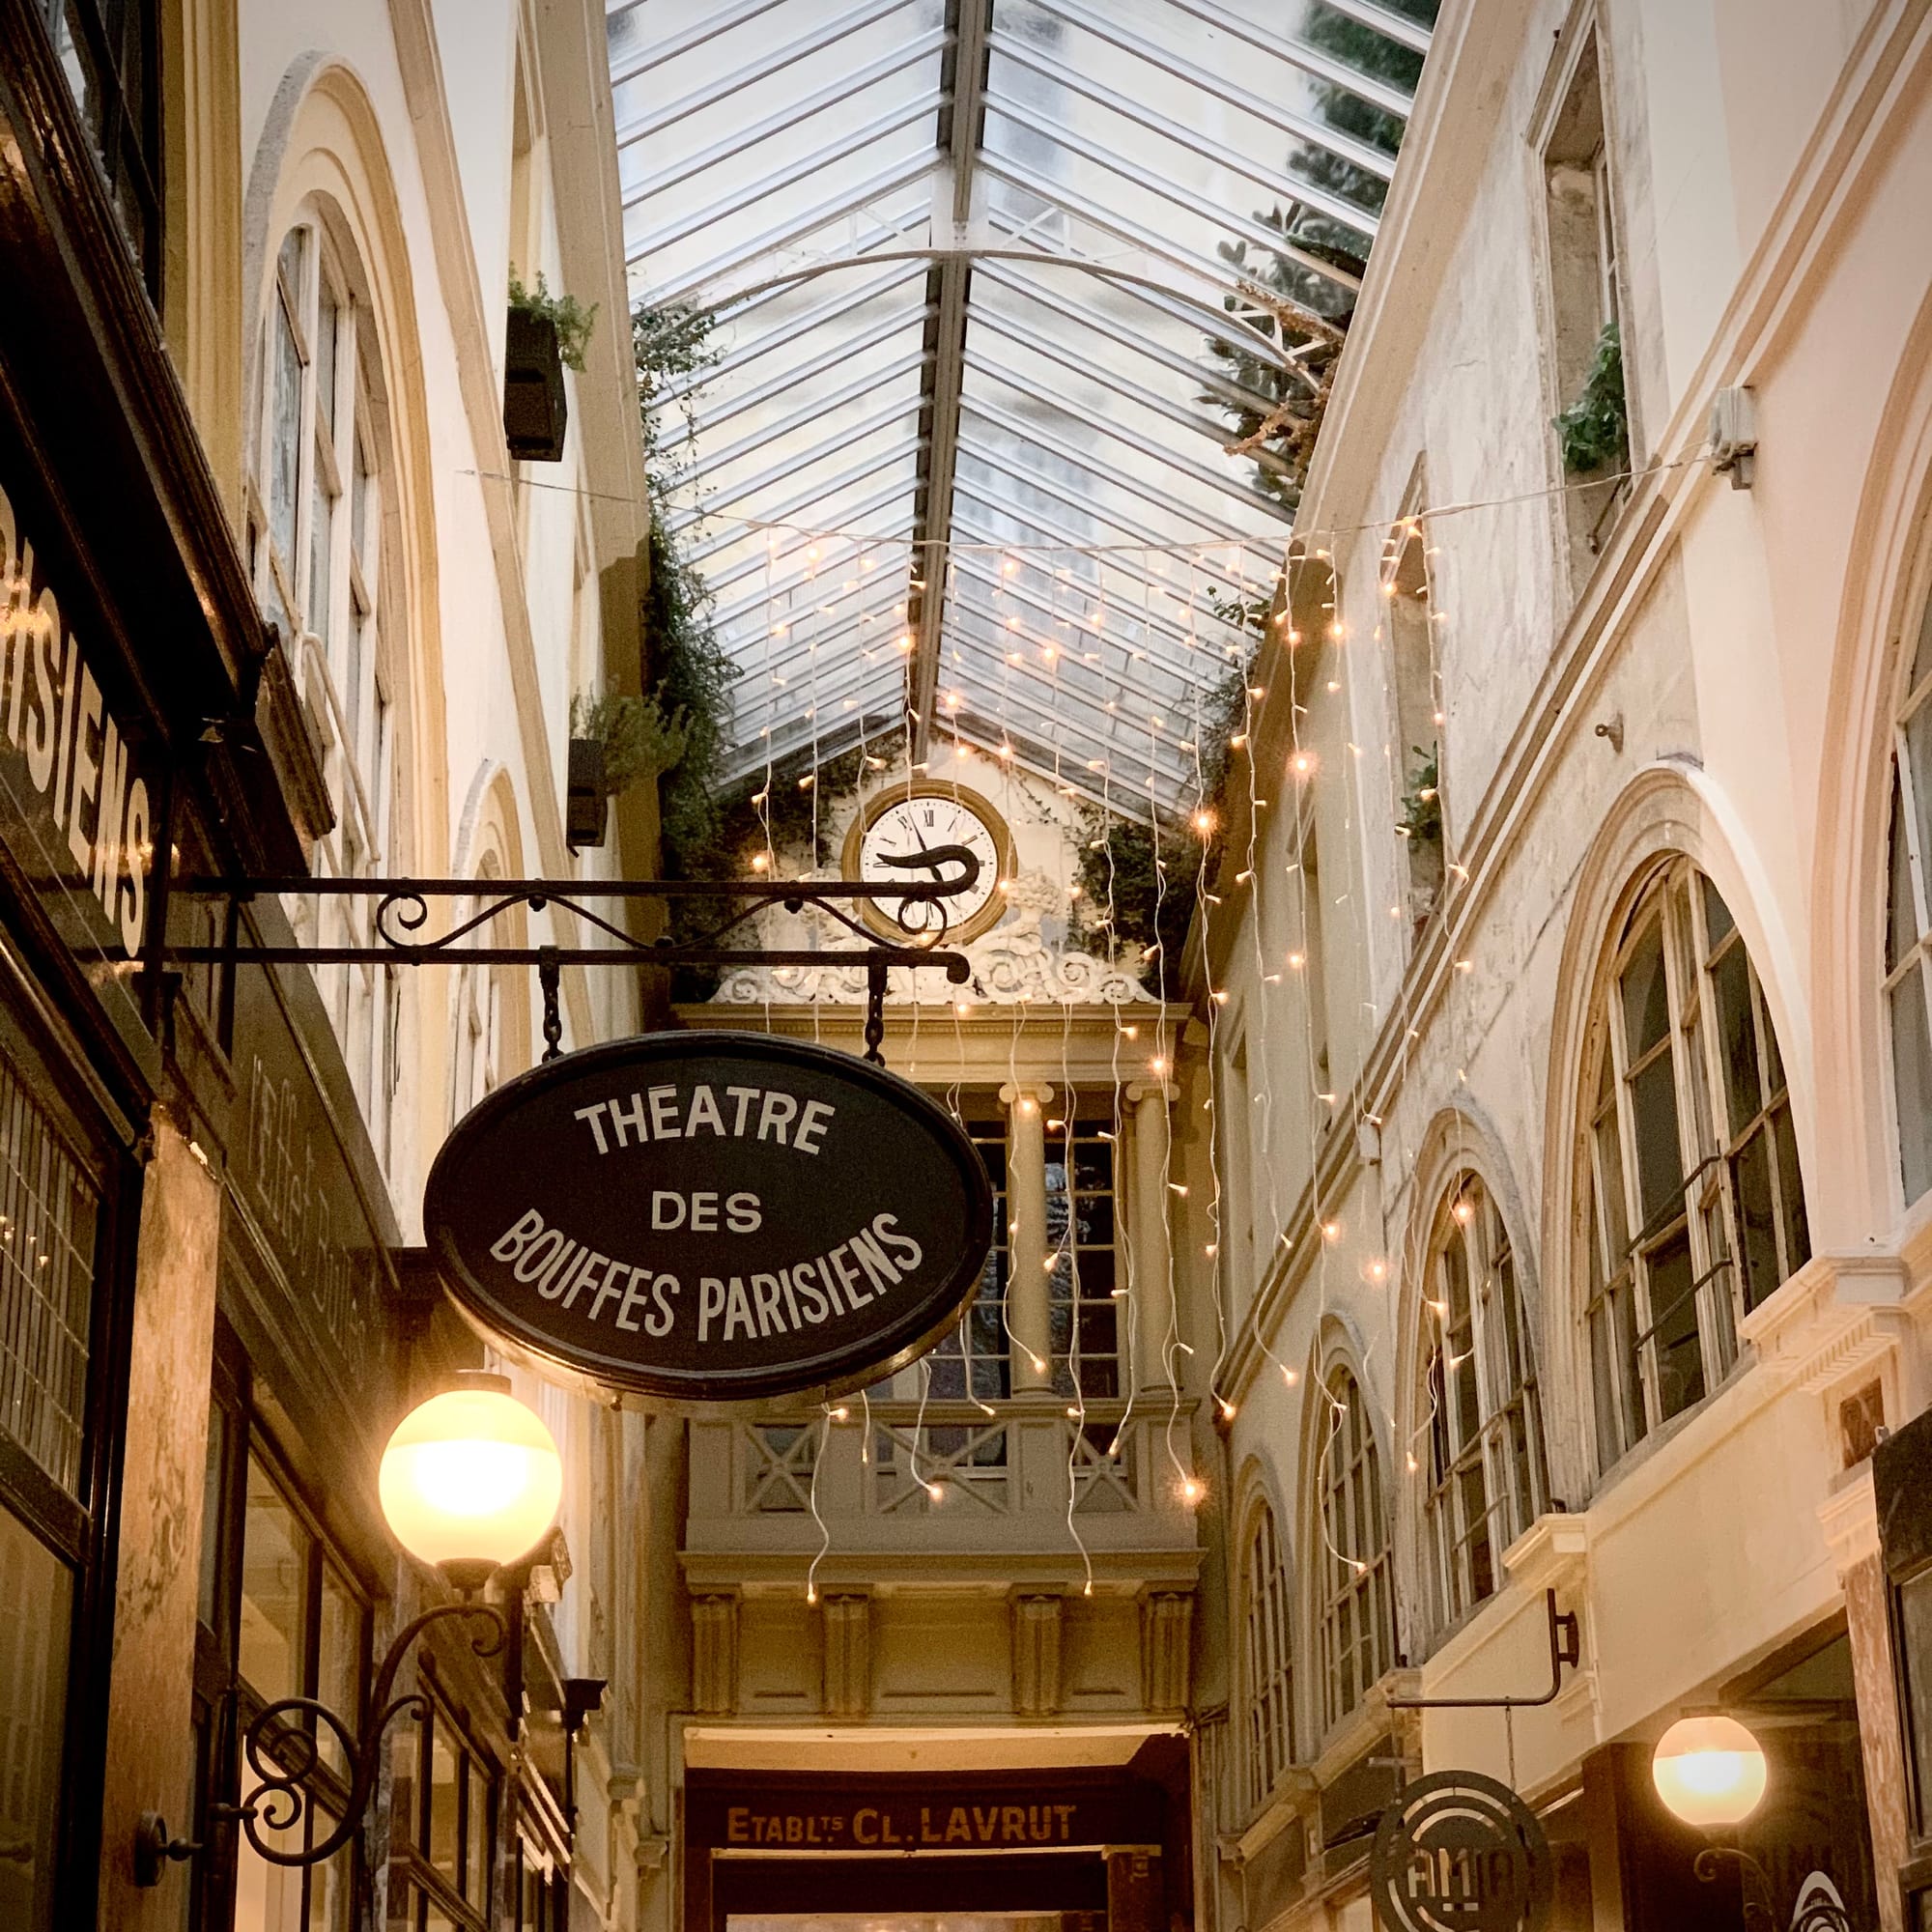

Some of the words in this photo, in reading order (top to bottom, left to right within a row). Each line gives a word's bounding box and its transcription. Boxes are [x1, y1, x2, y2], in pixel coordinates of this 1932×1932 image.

[651, 1190, 762, 1233] DES
[489, 1208, 680, 1337] BOUFFES
[697, 1213, 923, 1342] PARISIENS
[921, 1805, 1077, 1842] LAVRUT
